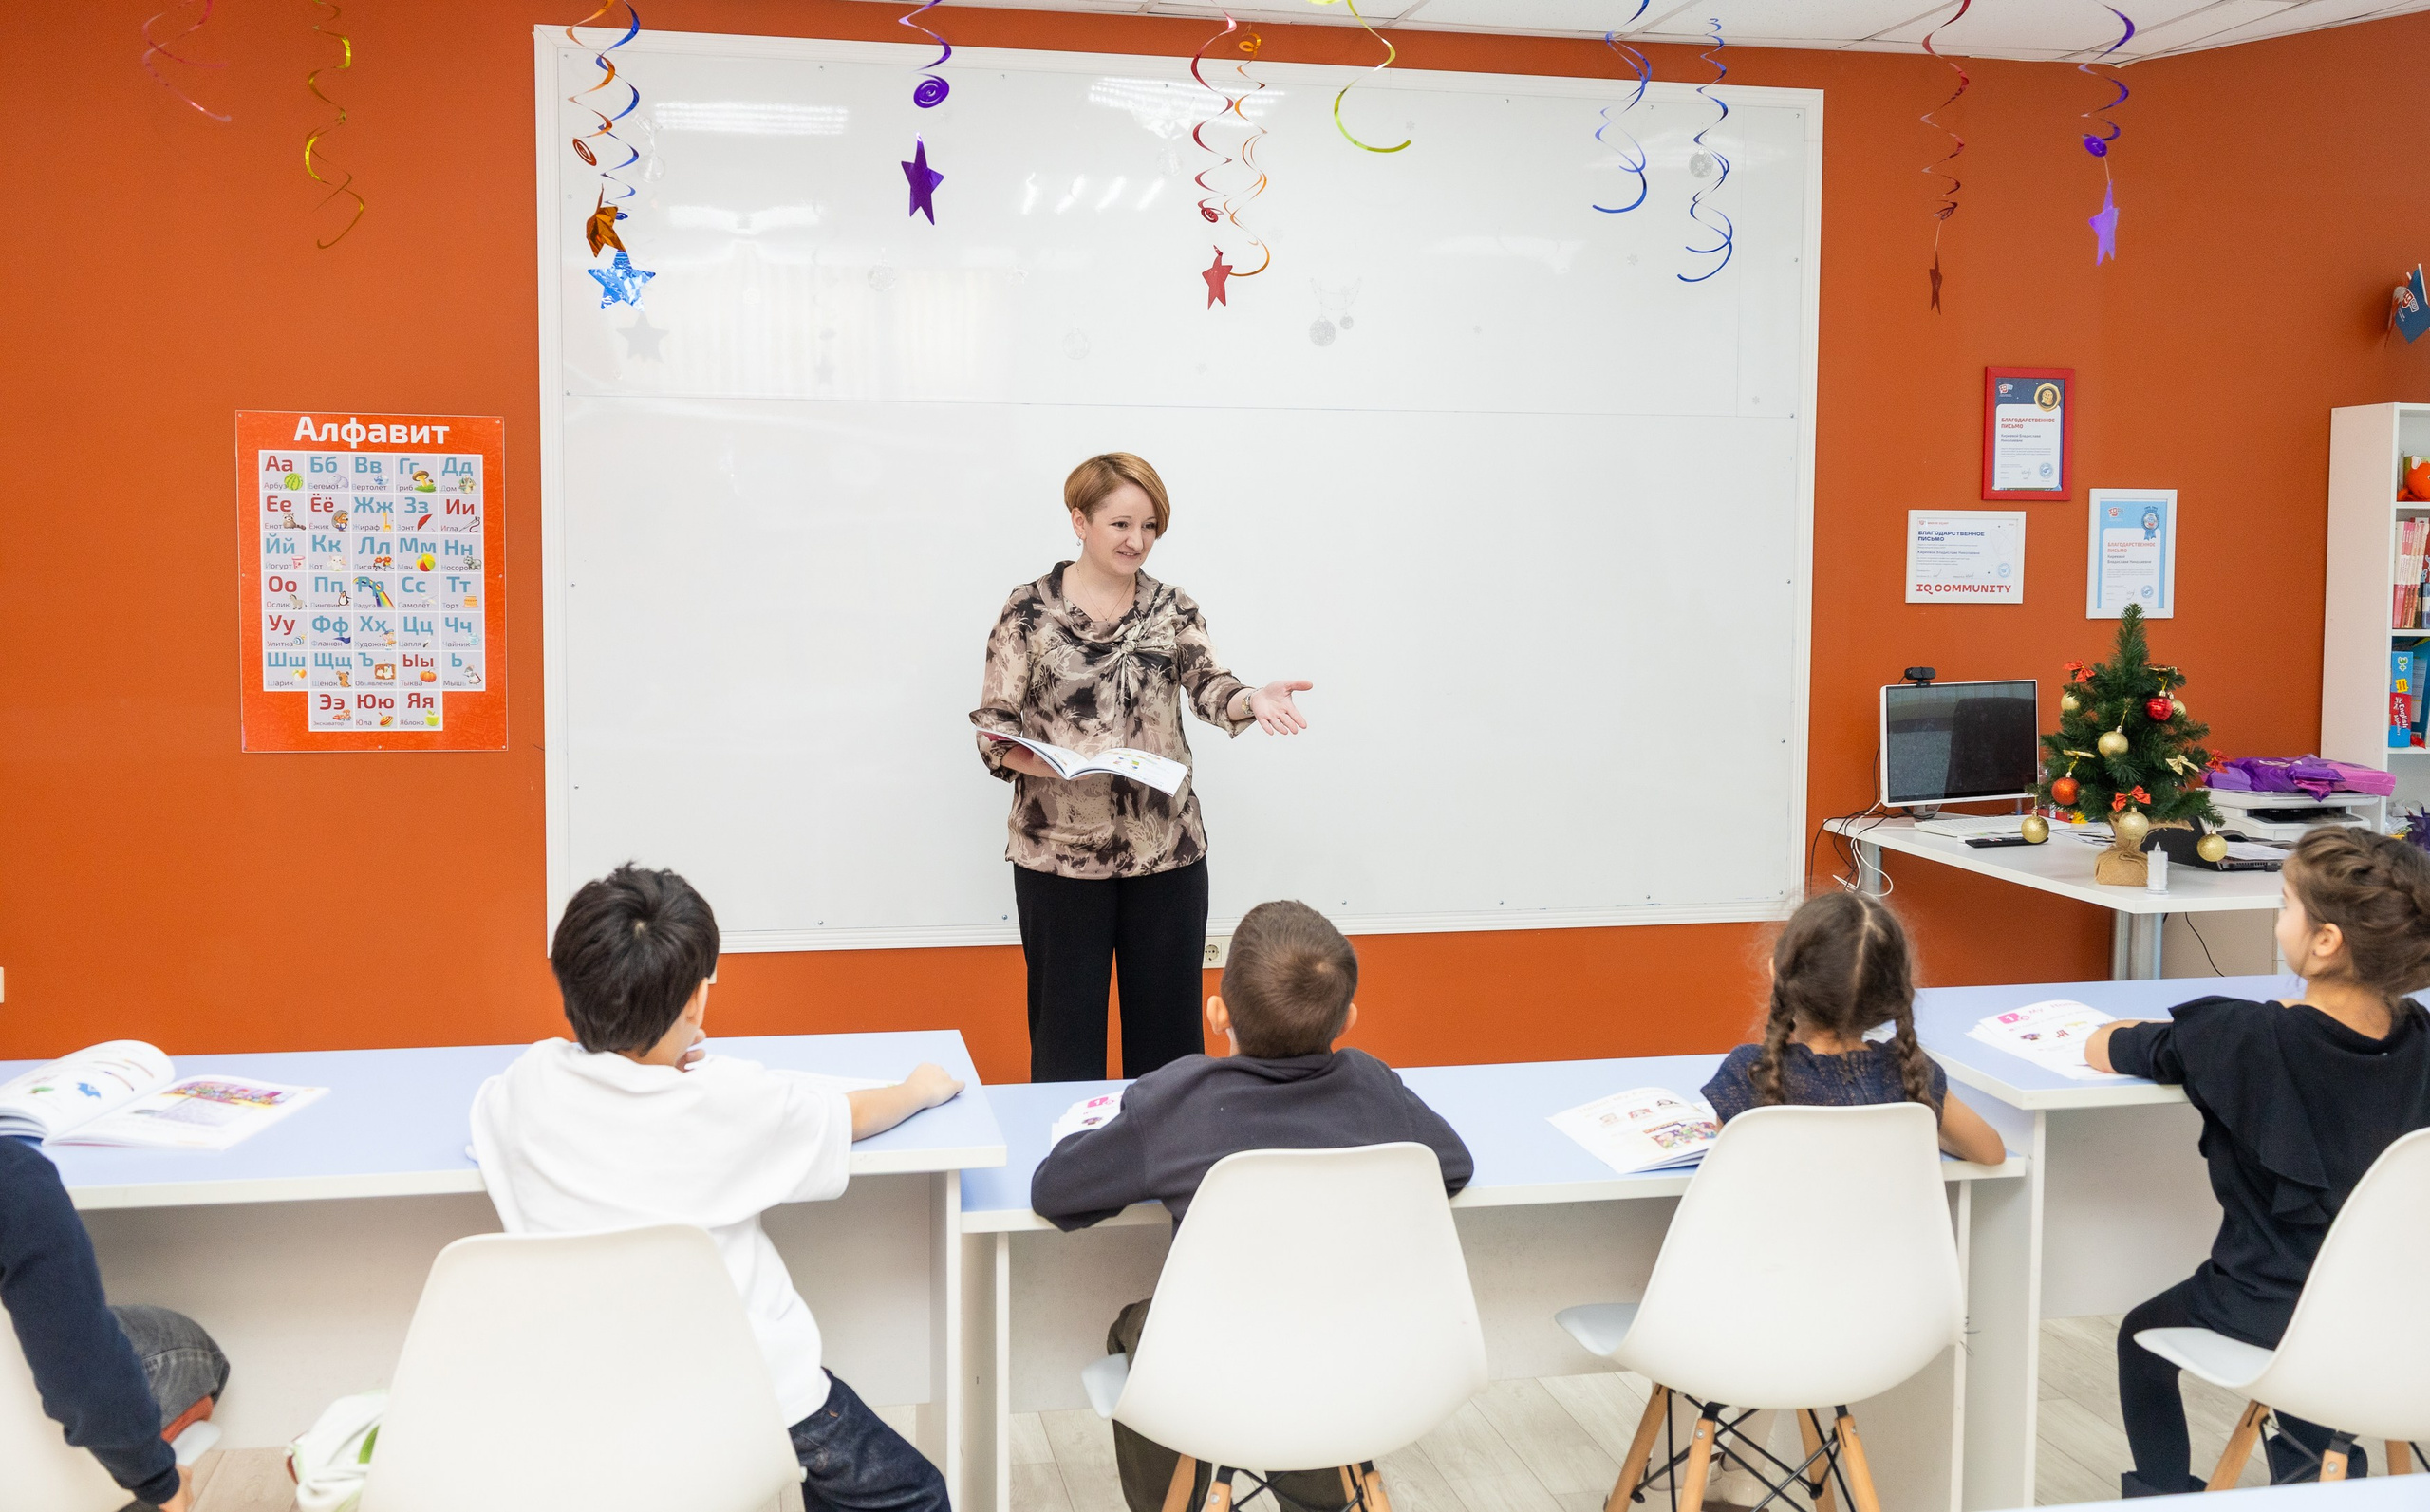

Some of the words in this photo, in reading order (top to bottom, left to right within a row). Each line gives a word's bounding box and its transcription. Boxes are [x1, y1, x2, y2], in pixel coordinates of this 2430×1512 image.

[293, 416, 450, 449] Алфавит
[265, 456, 293, 472] Аа
[310, 456, 337, 473] Бб
[355, 457, 382, 473] Вв
[400, 457, 419, 474] Гг
[441, 457, 473, 476] Дд
[267, 495, 291, 512] Ее
[310, 493, 334, 512] Ёё
[354, 496, 394, 513] Жж
[404, 496, 429, 513] Зз
[446, 499, 475, 514] Ии
[352, 523, 380, 532] Жираф
[266, 533, 295, 554] Йй
[312, 535, 342, 552] Кк
[358, 536, 390, 554] Лл
[400, 537, 436, 553] Мм
[445, 539, 473, 555] Нн
[268, 575, 297, 593] Оо
[314, 576, 343, 593] Пп
[357, 576, 384, 597] Рр
[402, 576, 426, 593] Сс
[446, 576, 471, 593] Тт
[1916, 584, 1933, 594] IQ
[1935, 584, 2011, 592] COMMUNITY
[268, 614, 296, 636] Уу
[311, 615, 349, 636] Фф
[359, 615, 386, 632] Хх
[403, 616, 434, 636] Цц
[444, 617, 472, 633] Чч
[267, 652, 306, 667] Шш
[314, 652, 352, 670] Щщ
[358, 652, 374, 667] Ъ
[402, 654, 434, 667] Ыы
[451, 652, 463, 667] Ь
[2398, 656, 2408, 672] 3+
[319, 694, 346, 710] Ээ
[357, 694, 394, 709] Юю
[407, 692, 434, 708] Яя
[2398, 703, 2409, 728] English
